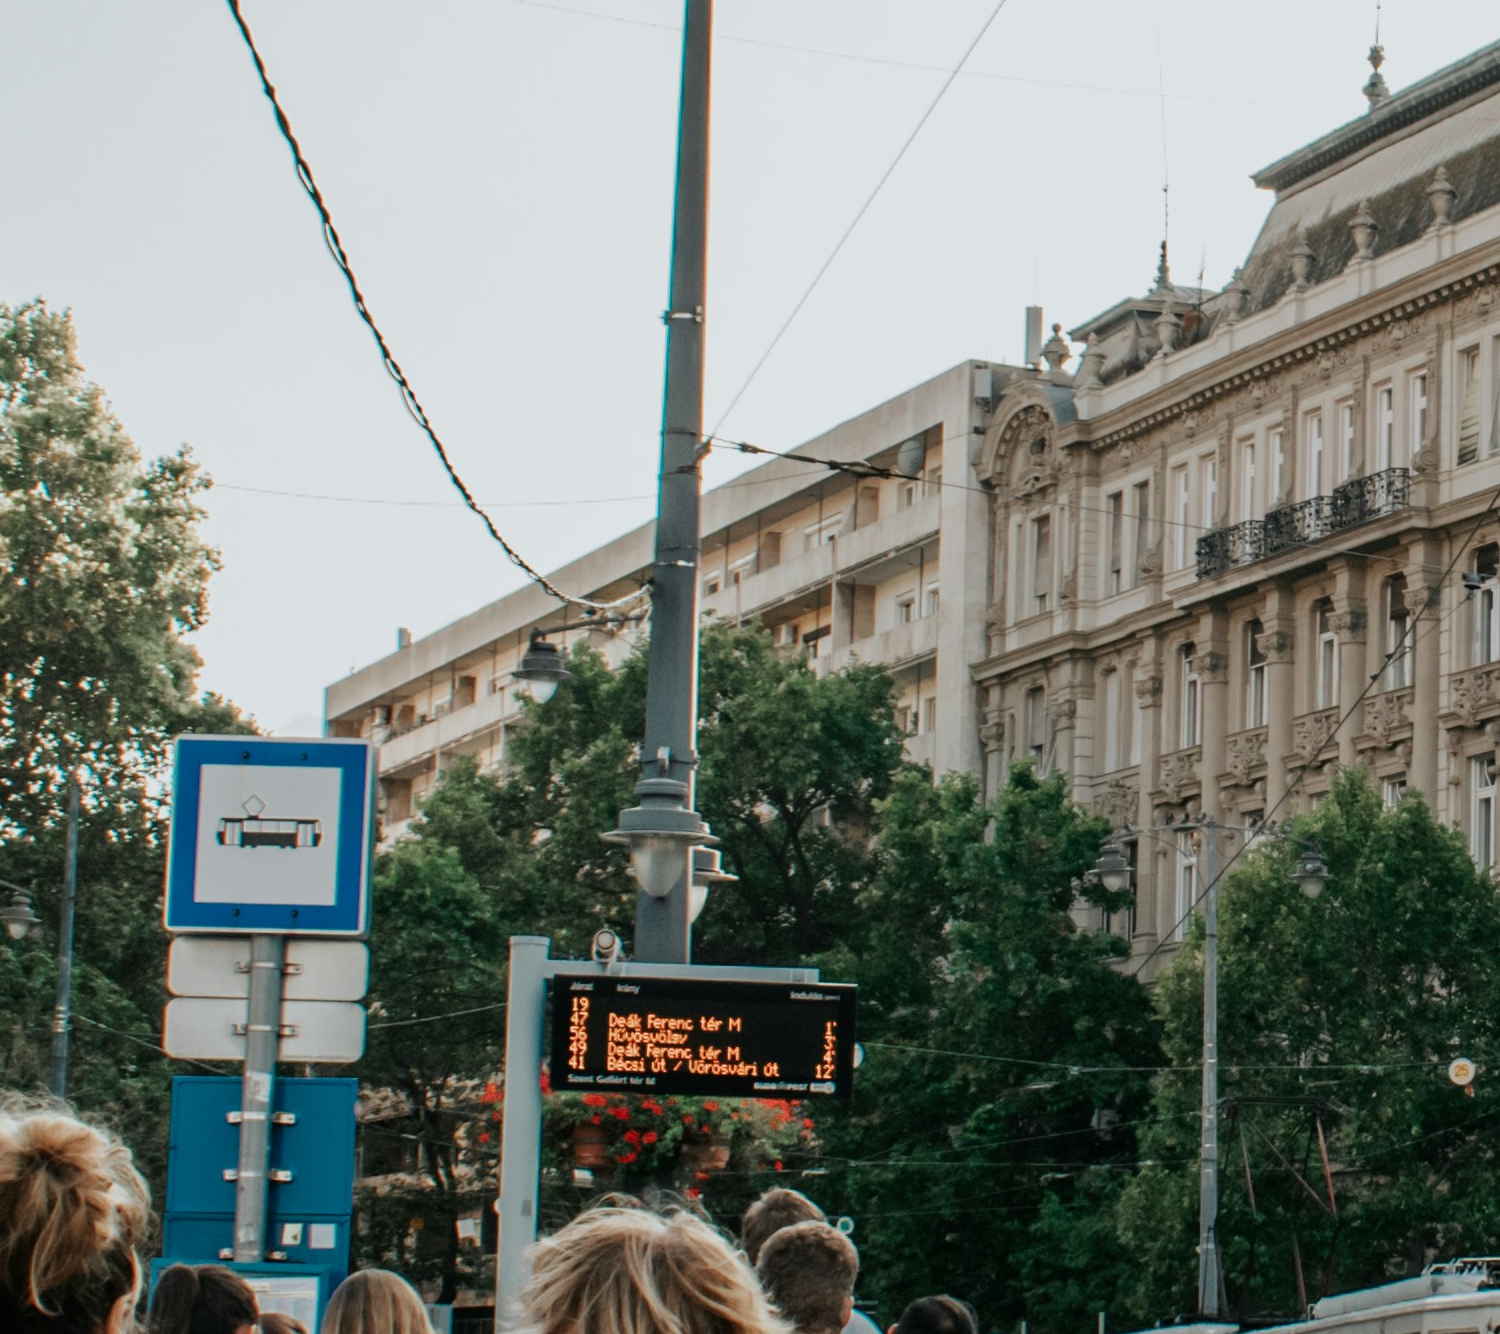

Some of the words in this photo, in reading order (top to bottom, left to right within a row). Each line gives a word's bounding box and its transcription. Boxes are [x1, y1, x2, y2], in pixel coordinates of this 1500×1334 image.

[571, 997, 590, 1012] 19
[570, 1012, 589, 1027] 47
[608, 1012, 642, 1028] Deák
[647, 1014, 693, 1030] Ferenc
[700, 1017, 723, 1031] tér
[728, 1017, 742, 1032] M
[569, 1027, 588, 1041] 56
[568, 1041, 587, 1056] 49
[607, 1041, 640, 1058] Deák
[646, 1043, 692, 1059] Ferenc
[699, 1045, 721, 1061] tér
[727, 1046, 740, 1061] M
[568, 1055, 585, 1070] 41
[607, 1056, 645, 1072] Bécsi
[651, 1058, 667, 1073] út
[689, 1059, 758, 1076] Vörösvári
